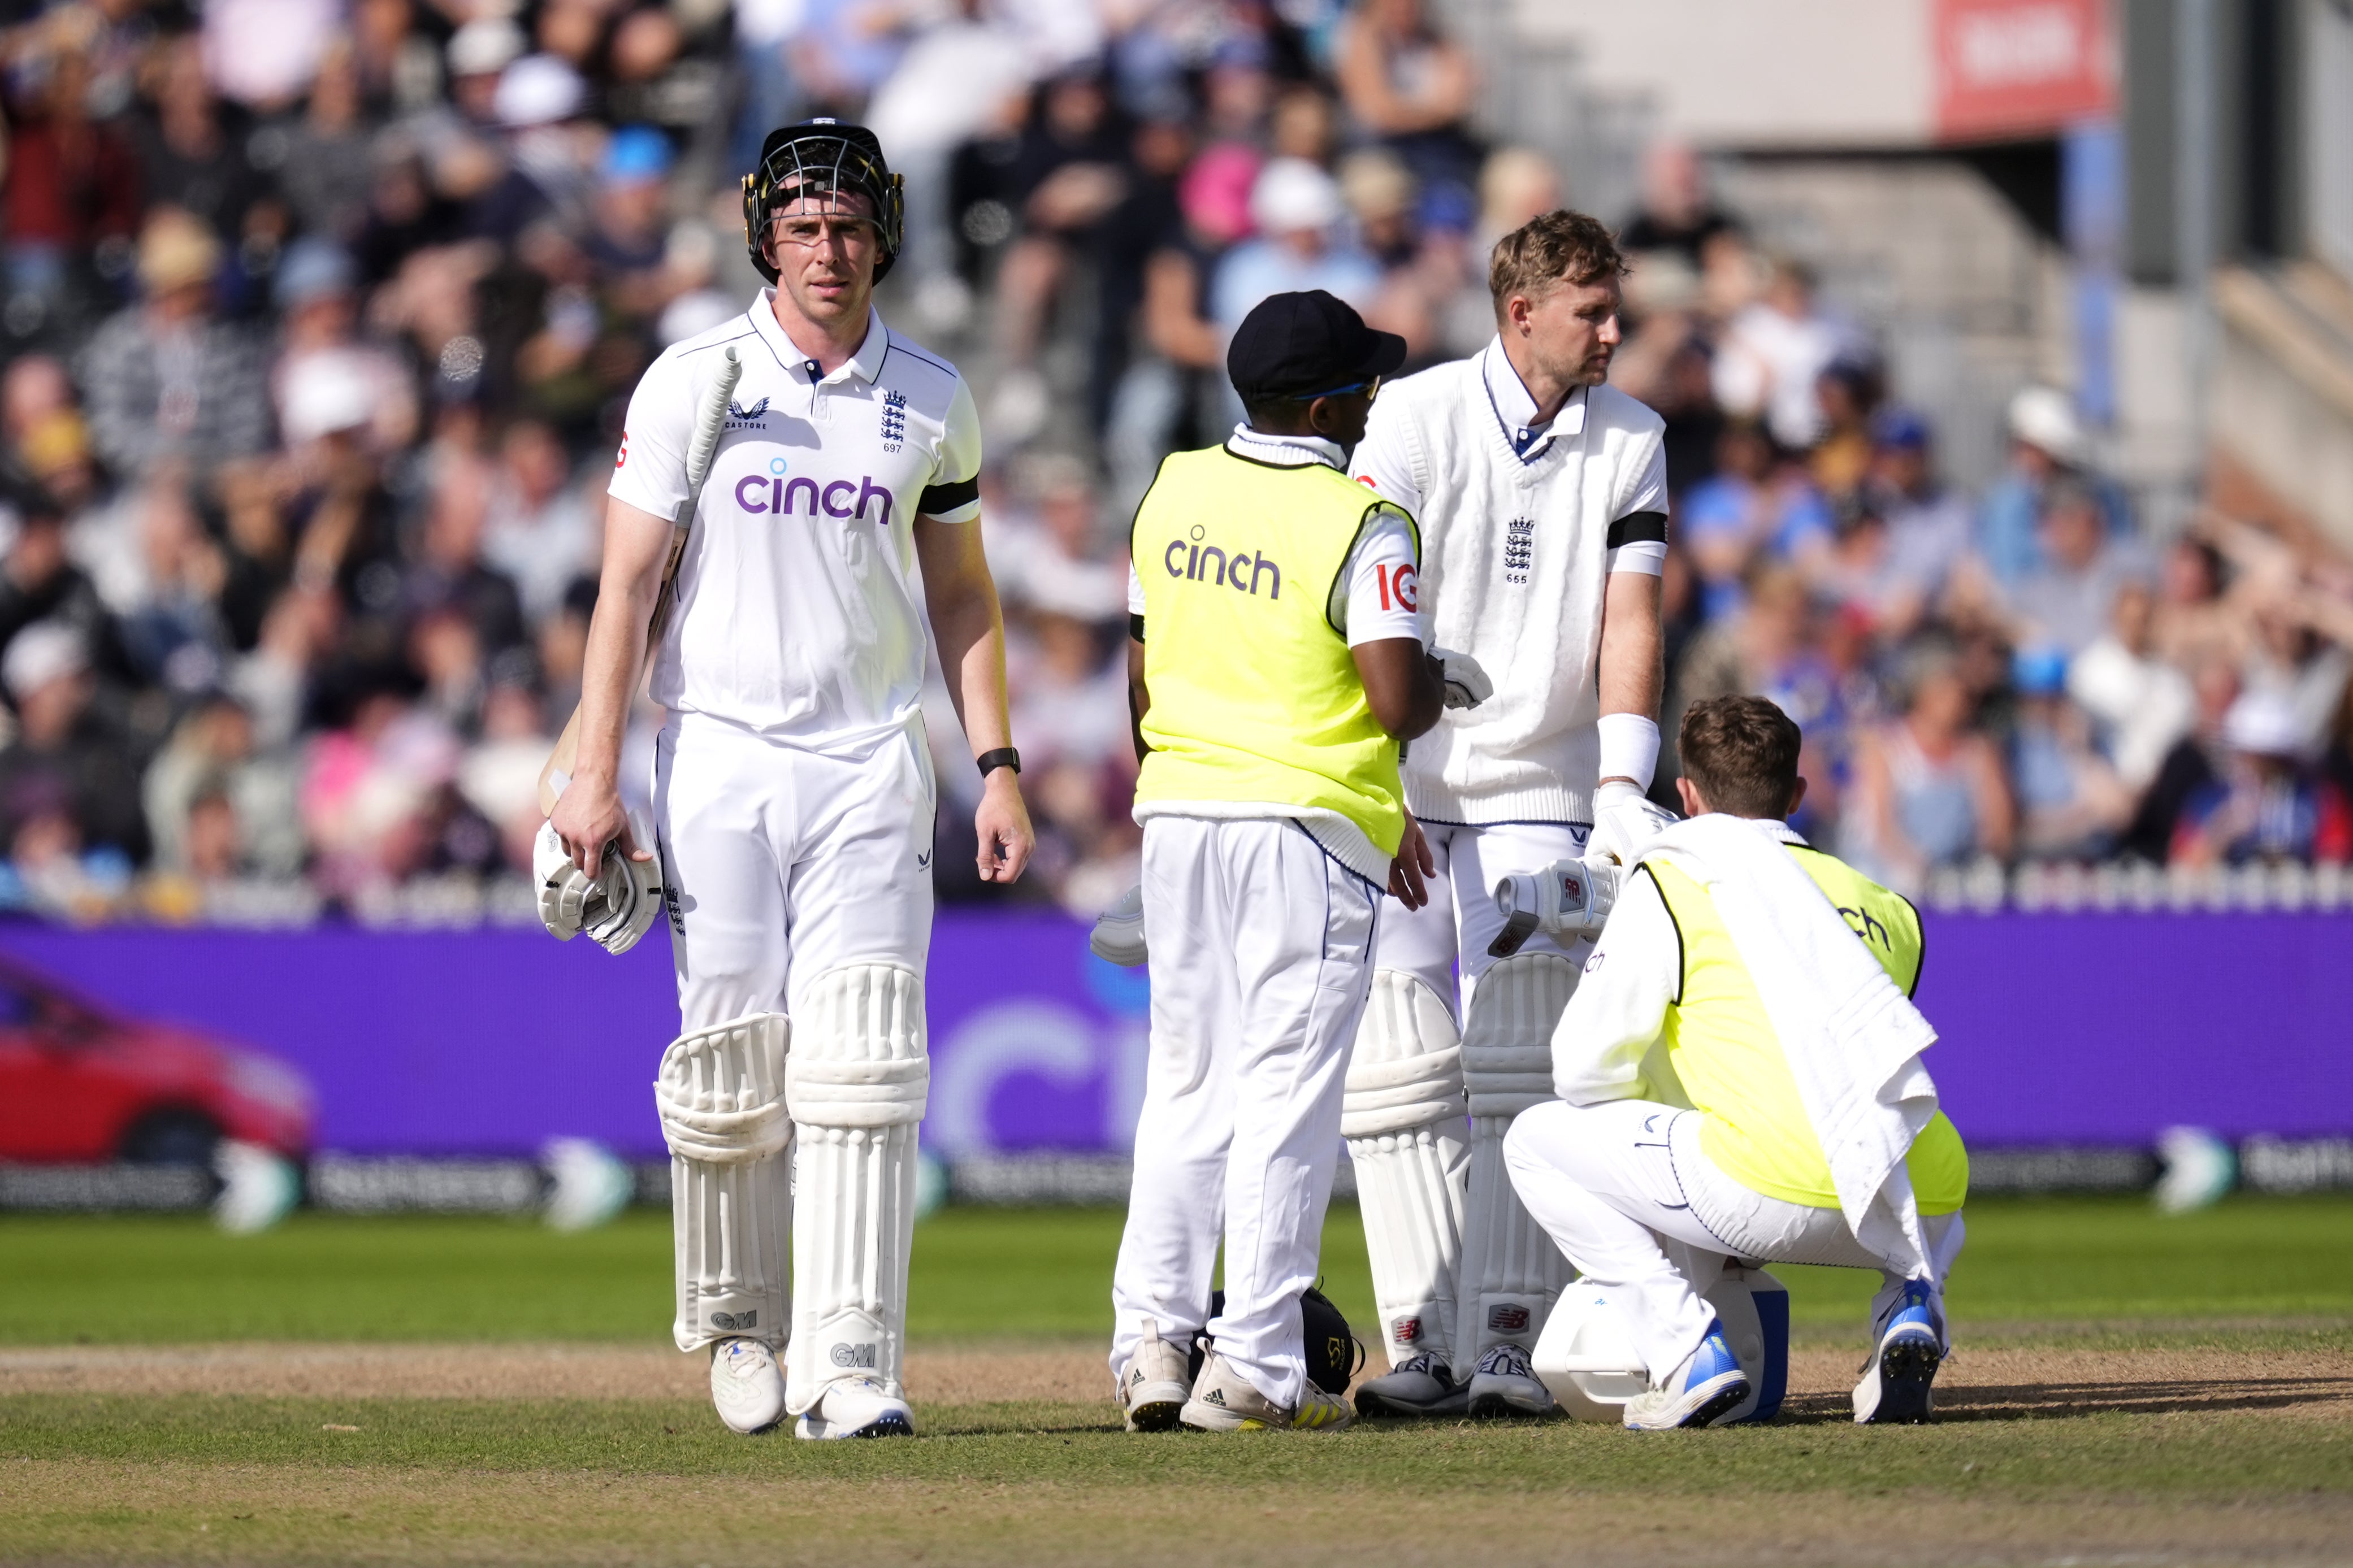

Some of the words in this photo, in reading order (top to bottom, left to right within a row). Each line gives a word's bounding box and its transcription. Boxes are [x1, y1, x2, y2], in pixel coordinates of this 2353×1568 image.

[884, 443, 901, 453] 697
[735, 457, 892, 525] cinch
[1165, 524, 1280, 600] cinch
[1377, 564, 1417, 613] IG
[710, 1310, 757, 1330] GM
[830, 1343, 875, 1367] GM
[1203, 1396, 1227, 1407] adidas
